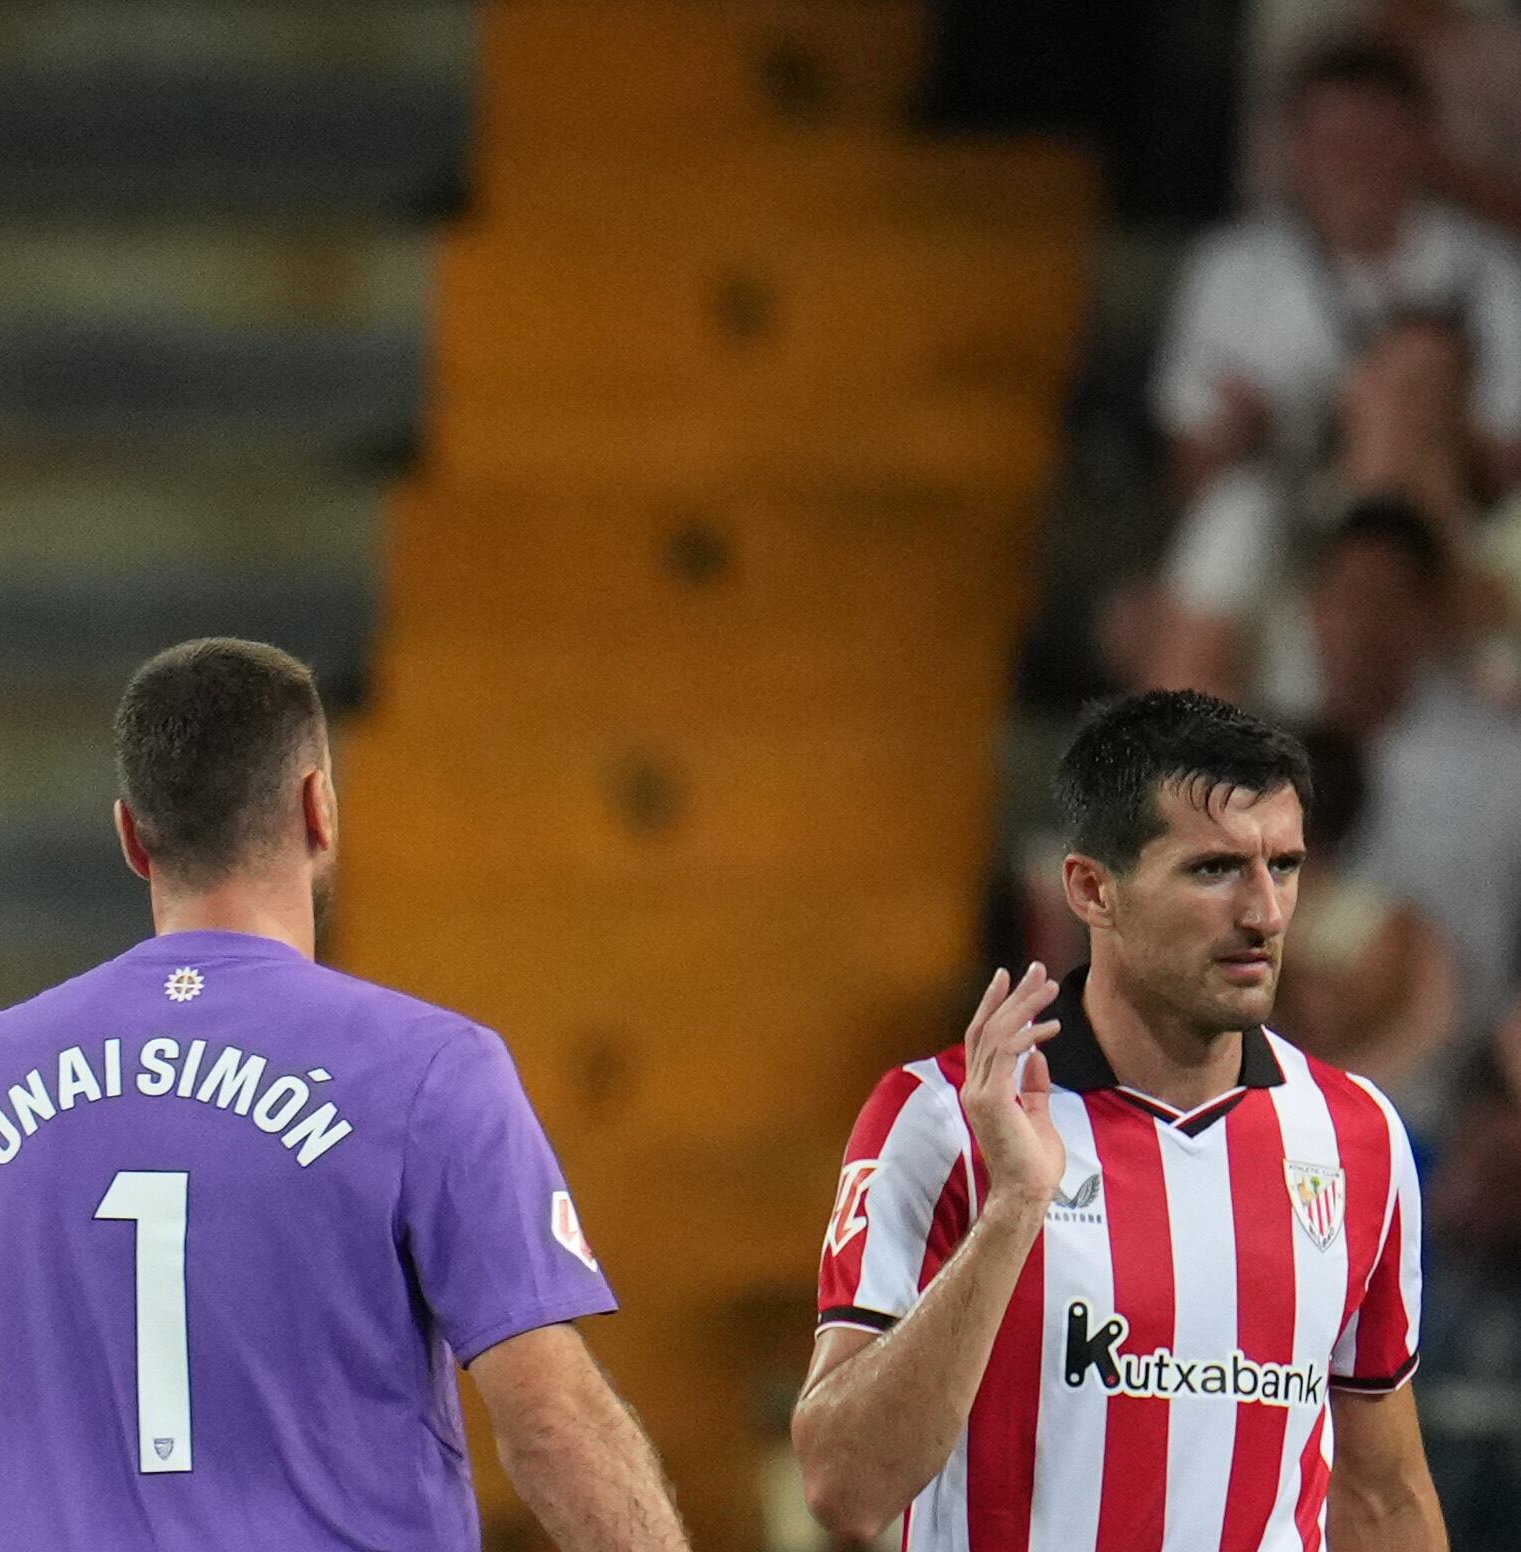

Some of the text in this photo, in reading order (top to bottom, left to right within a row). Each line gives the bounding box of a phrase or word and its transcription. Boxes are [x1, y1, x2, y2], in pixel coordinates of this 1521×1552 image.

[135, 1037, 353, 1168] SIMÓN
[91, 1169, 193, 1474] 1
[1064, 1301, 1324, 1405] Kutxabank
